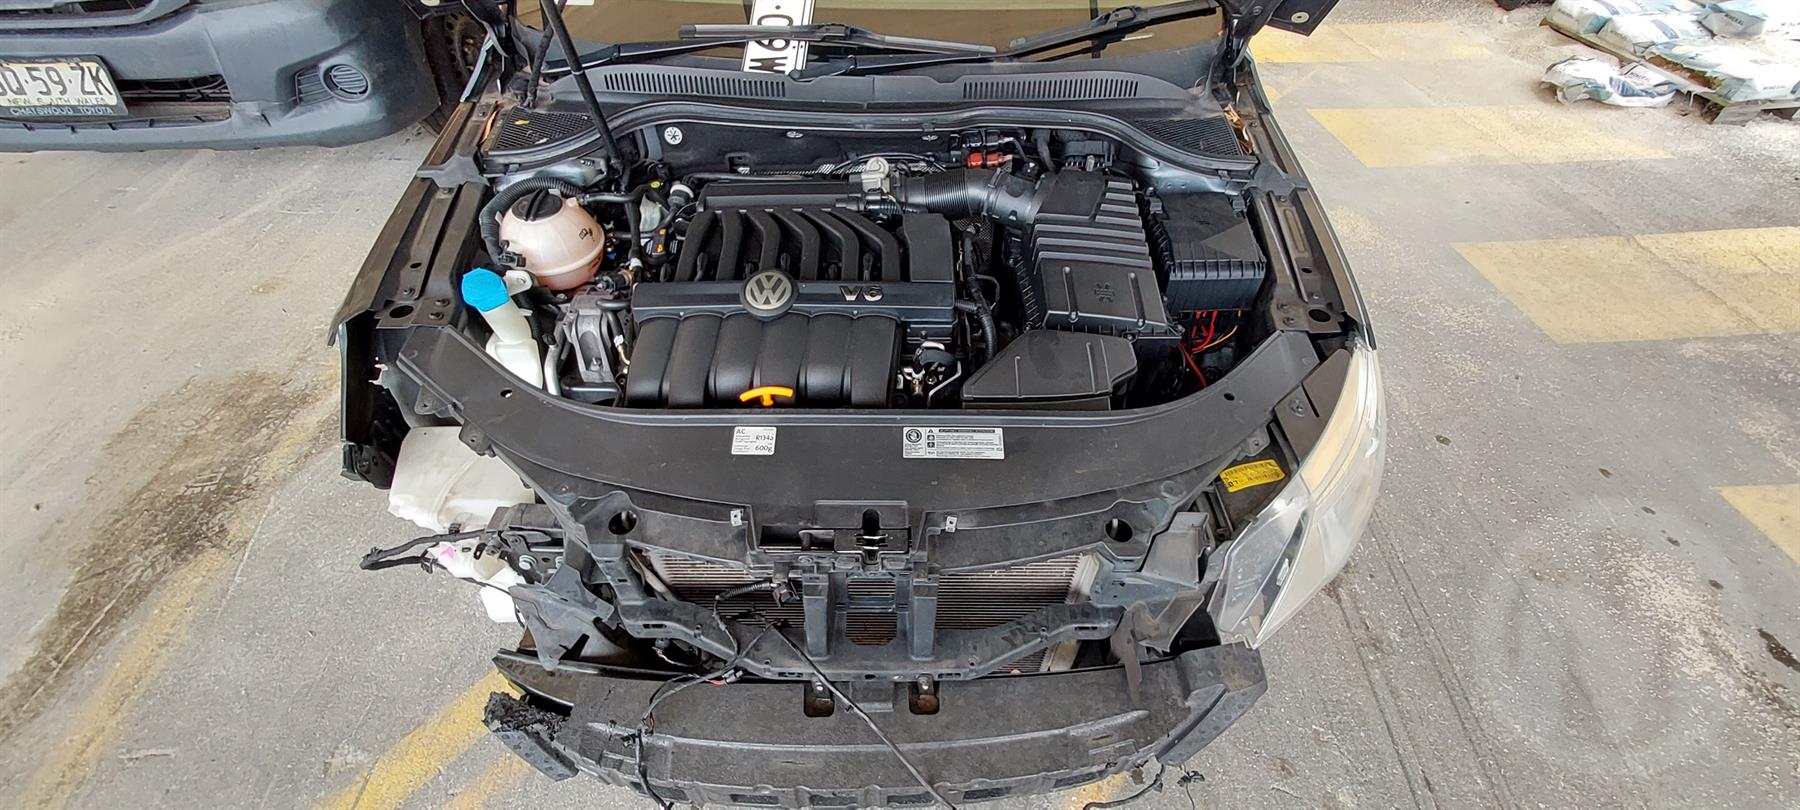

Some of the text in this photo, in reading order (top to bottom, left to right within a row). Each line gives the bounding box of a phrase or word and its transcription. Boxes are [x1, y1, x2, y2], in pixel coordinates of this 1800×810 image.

[10, 106, 114, 116] CHATSWOOD TOYOTA
[839, 285, 884, 301] V6
[755, 444, 773, 453] 600g
